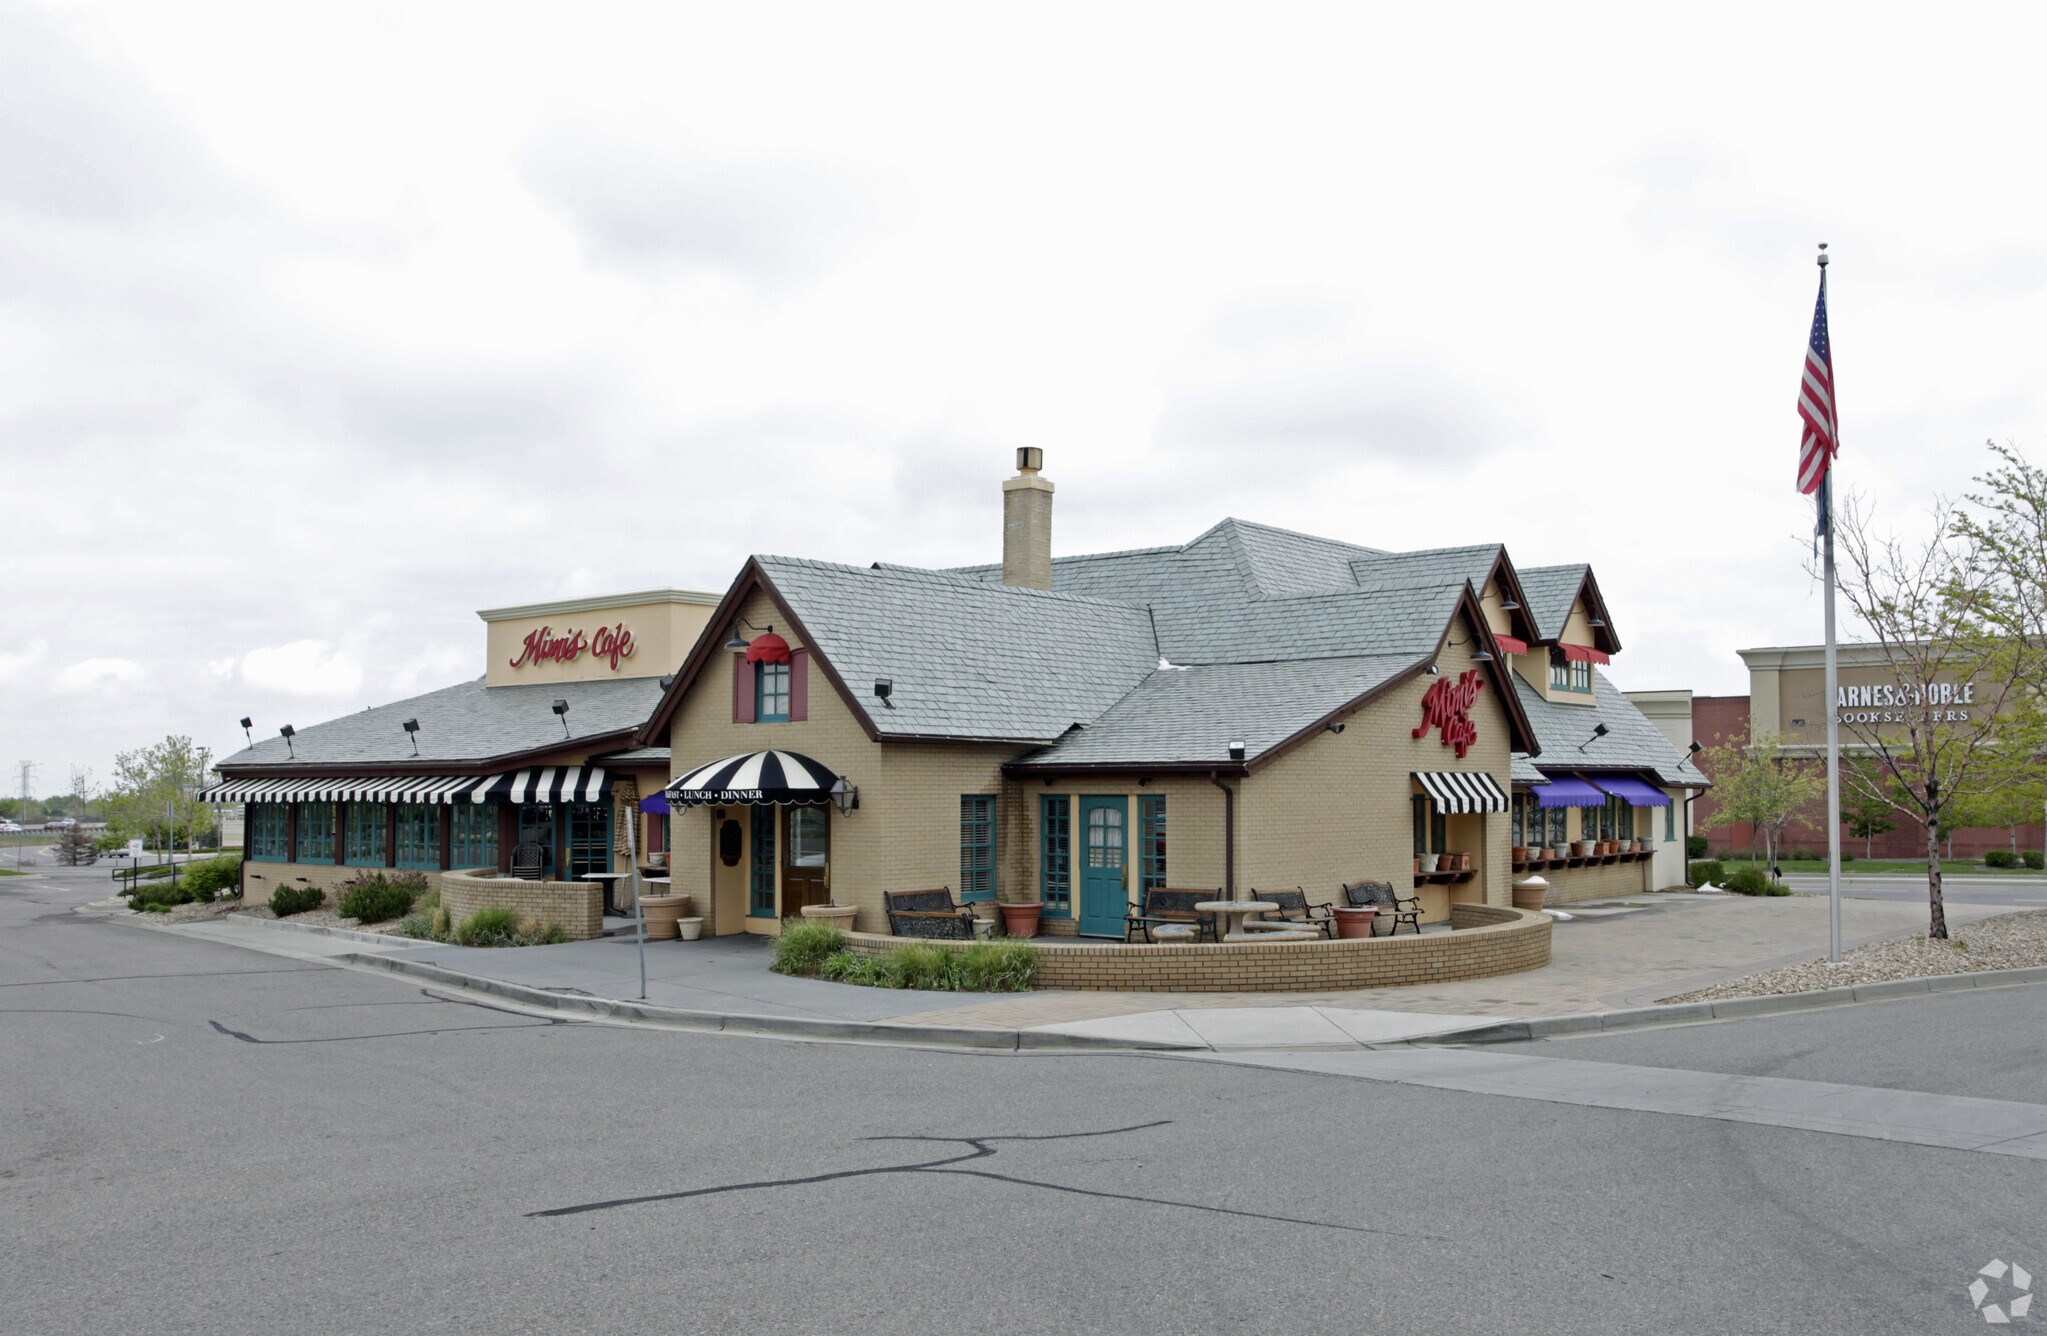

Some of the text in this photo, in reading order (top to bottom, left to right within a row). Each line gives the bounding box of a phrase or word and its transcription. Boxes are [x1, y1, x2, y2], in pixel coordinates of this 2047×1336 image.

[1837, 684, 1893, 707] ARNES
[1837, 710, 1968, 723] OOKSEERS
[684, 790, 712, 800] LUNCH
[721, 789, 763, 800] DINNER
